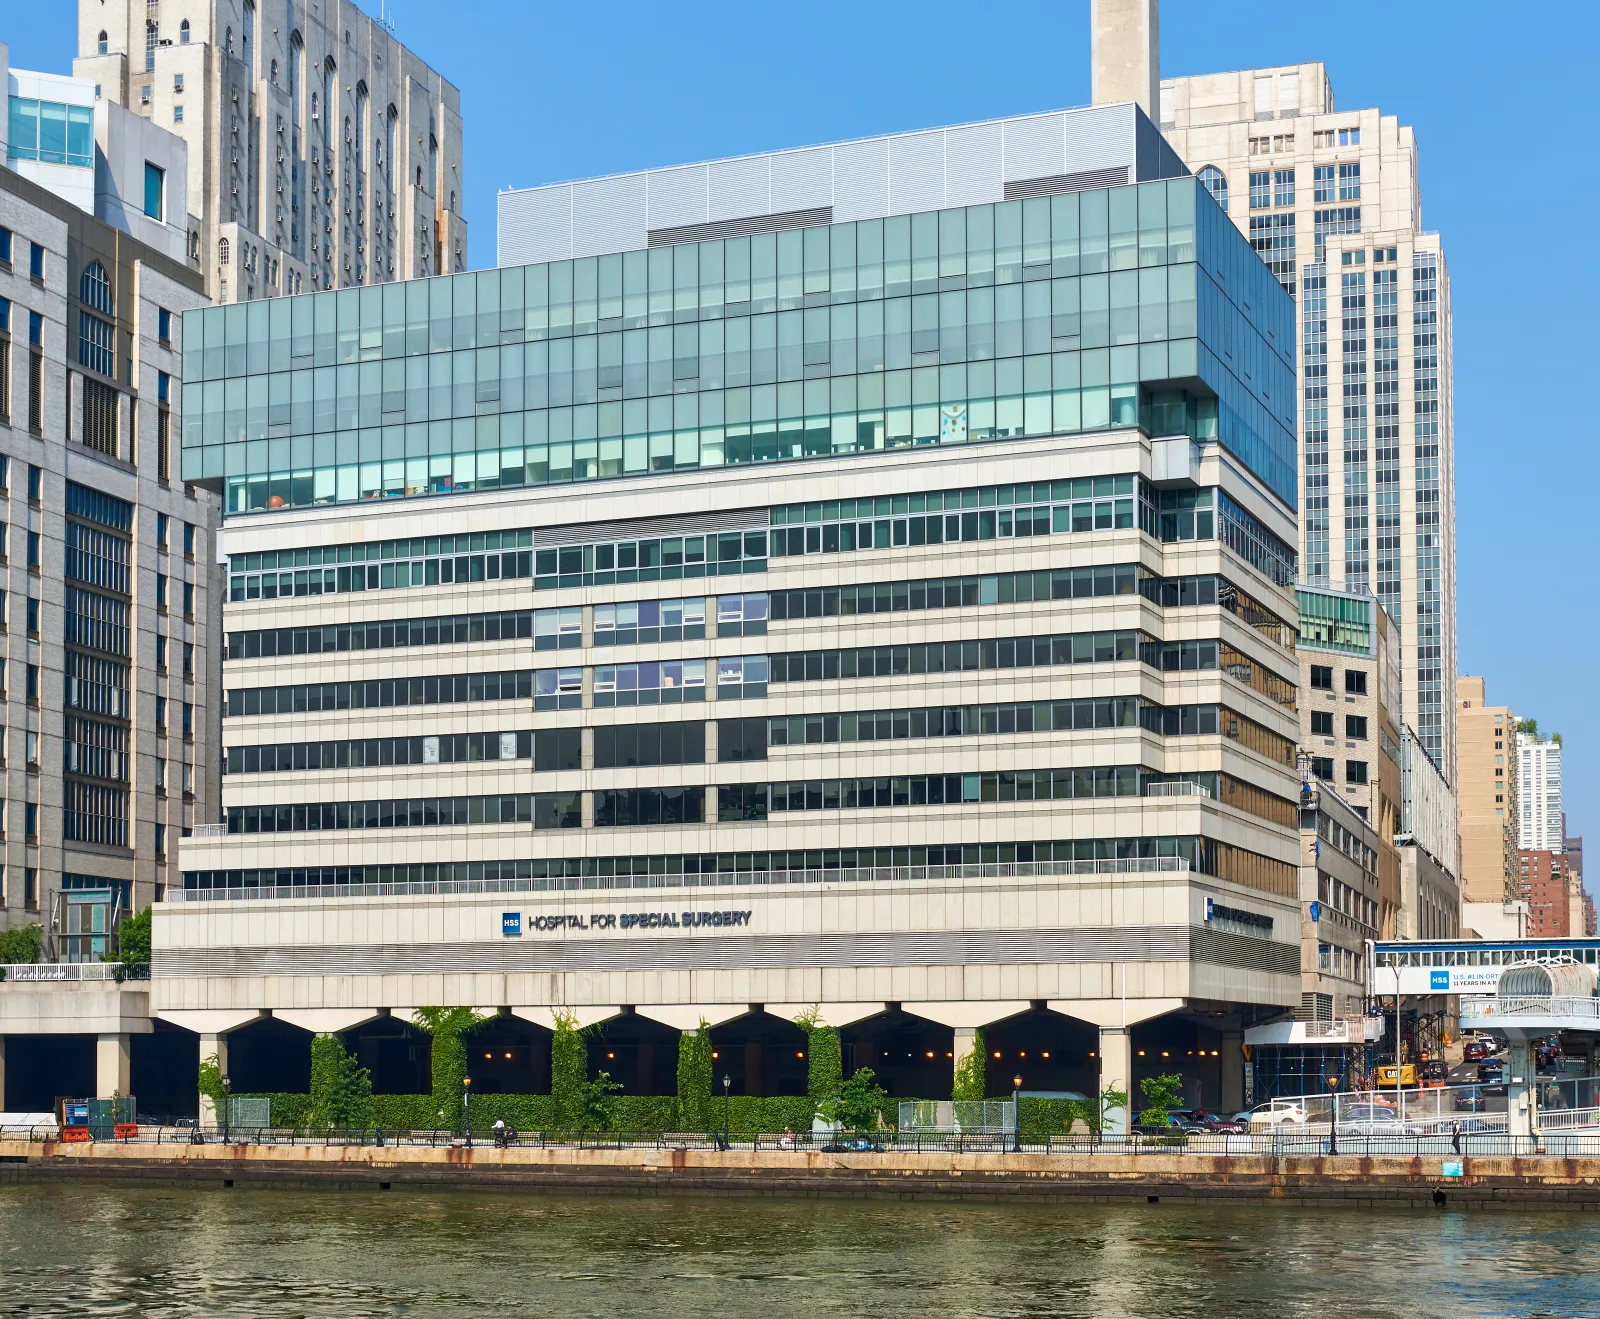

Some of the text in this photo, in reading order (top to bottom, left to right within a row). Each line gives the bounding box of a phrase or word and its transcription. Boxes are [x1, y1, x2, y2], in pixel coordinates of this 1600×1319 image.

[528, 911, 752, 931] HOSPITAL FOR SPECIAL SURGERY
[1432, 976, 1448, 984] HSS
